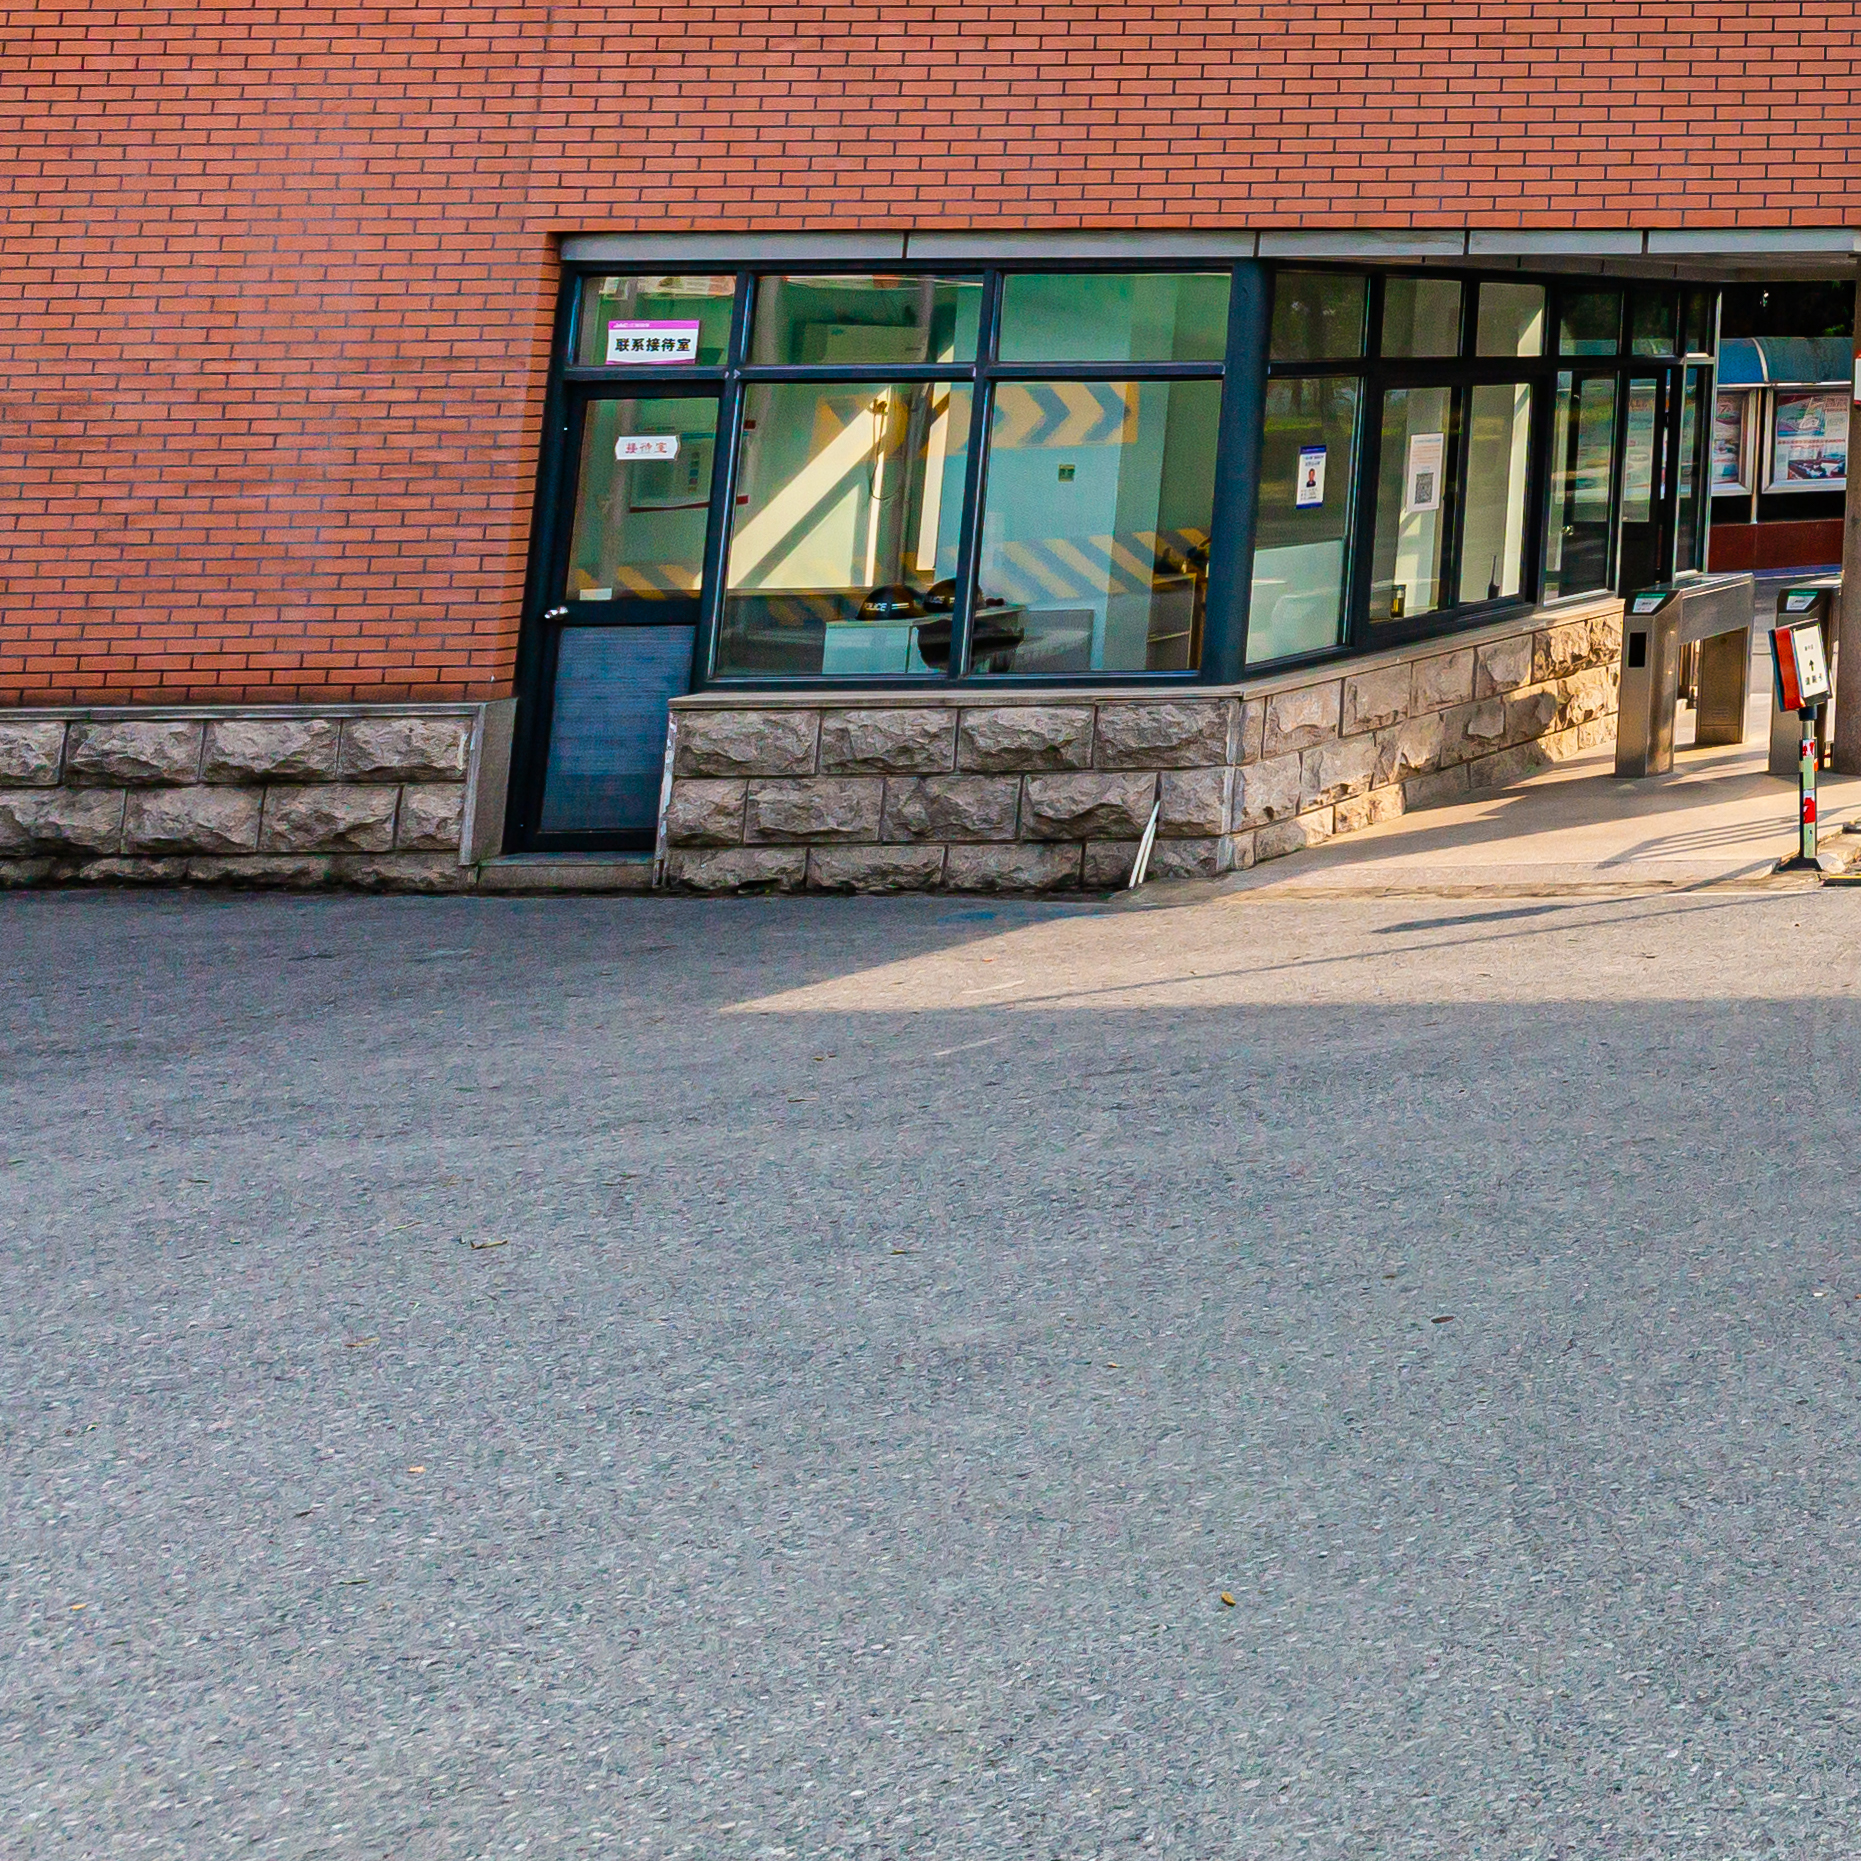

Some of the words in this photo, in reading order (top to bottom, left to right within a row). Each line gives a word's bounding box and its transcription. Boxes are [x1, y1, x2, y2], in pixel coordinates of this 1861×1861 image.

[614, 337, 692, 352] 联系接待室
[625, 441, 668, 454] 接待室
